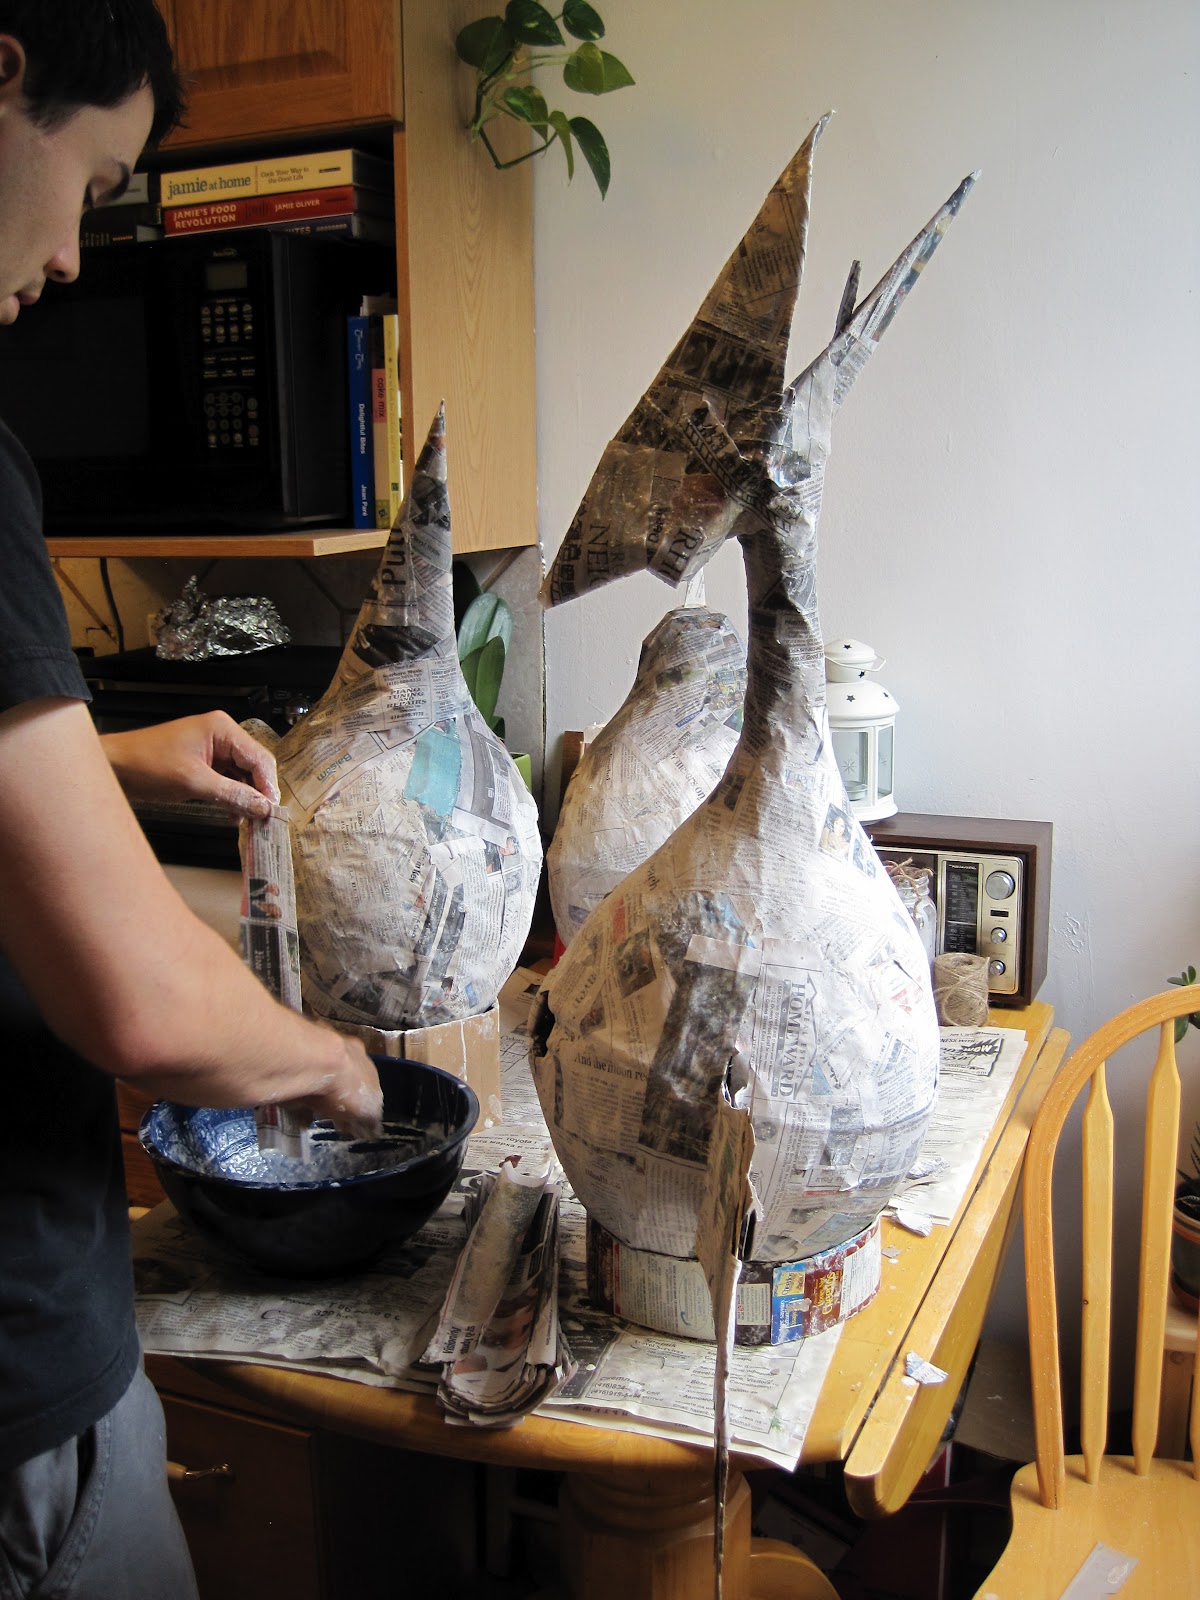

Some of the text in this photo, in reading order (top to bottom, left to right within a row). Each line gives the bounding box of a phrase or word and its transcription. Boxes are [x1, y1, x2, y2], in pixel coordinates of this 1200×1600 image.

[260, 170, 274, 178] Cook
[275, 169, 290, 178] Your
[290, 168, 303, 177] Way
[168, 175, 250, 199] jamie at home
[174, 204, 237, 220] JAMIE'S FOOD
[275, 199, 320, 212] JAMIE OLIVER
[175, 214, 236, 229] REVOLUTION
[358, 404, 367, 436] Delightful
[388, 692, 424, 700] TUNING
[390, 687, 420, 695] PIANO
[386, 700, 427, 708] REPAIRS
[316, 753, 352, 781] Balsam
[780, 983, 805, 1096] HOMEWARD
[796, 1043, 806, 1079] ESTATE
[607, 1062, 632, 1080] moon
[822, 1271, 836, 1315] Cheerios
[443, 1326, 461, 1354] Visioning
